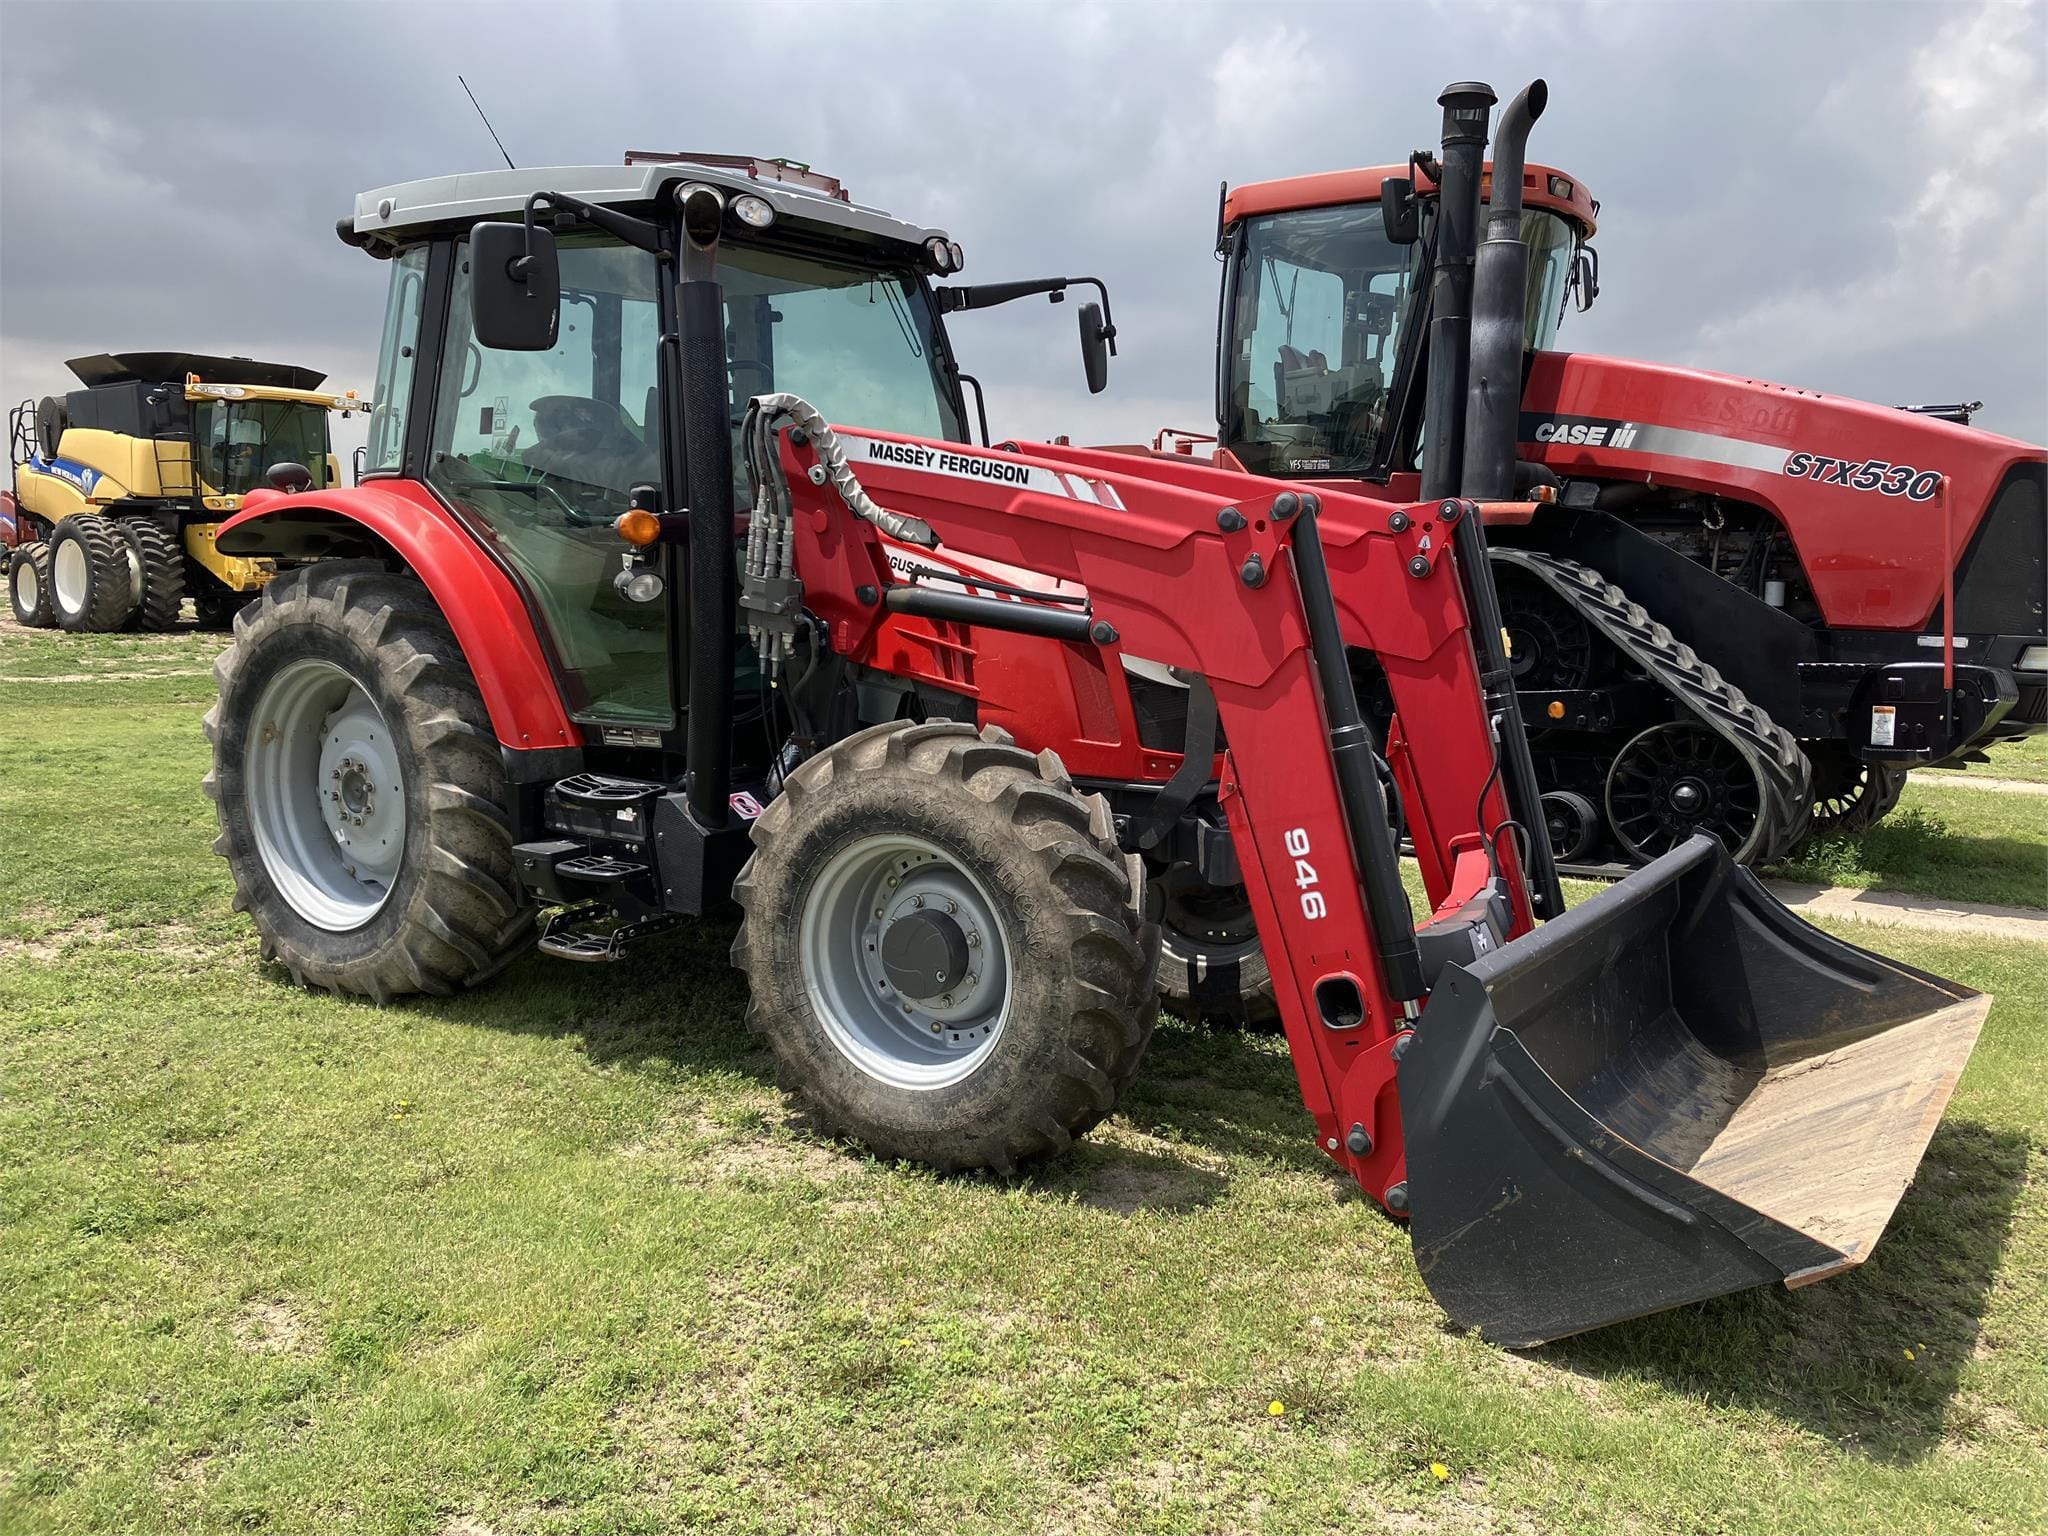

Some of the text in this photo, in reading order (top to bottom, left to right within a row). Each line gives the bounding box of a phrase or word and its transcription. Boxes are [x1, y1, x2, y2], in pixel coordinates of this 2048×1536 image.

[1535, 422, 1608, 446] CASE
[869, 442, 1030, 485] MASSEY FERGUSON
[1786, 452, 1943, 502] STX530
[1284, 827, 1327, 920] 946
